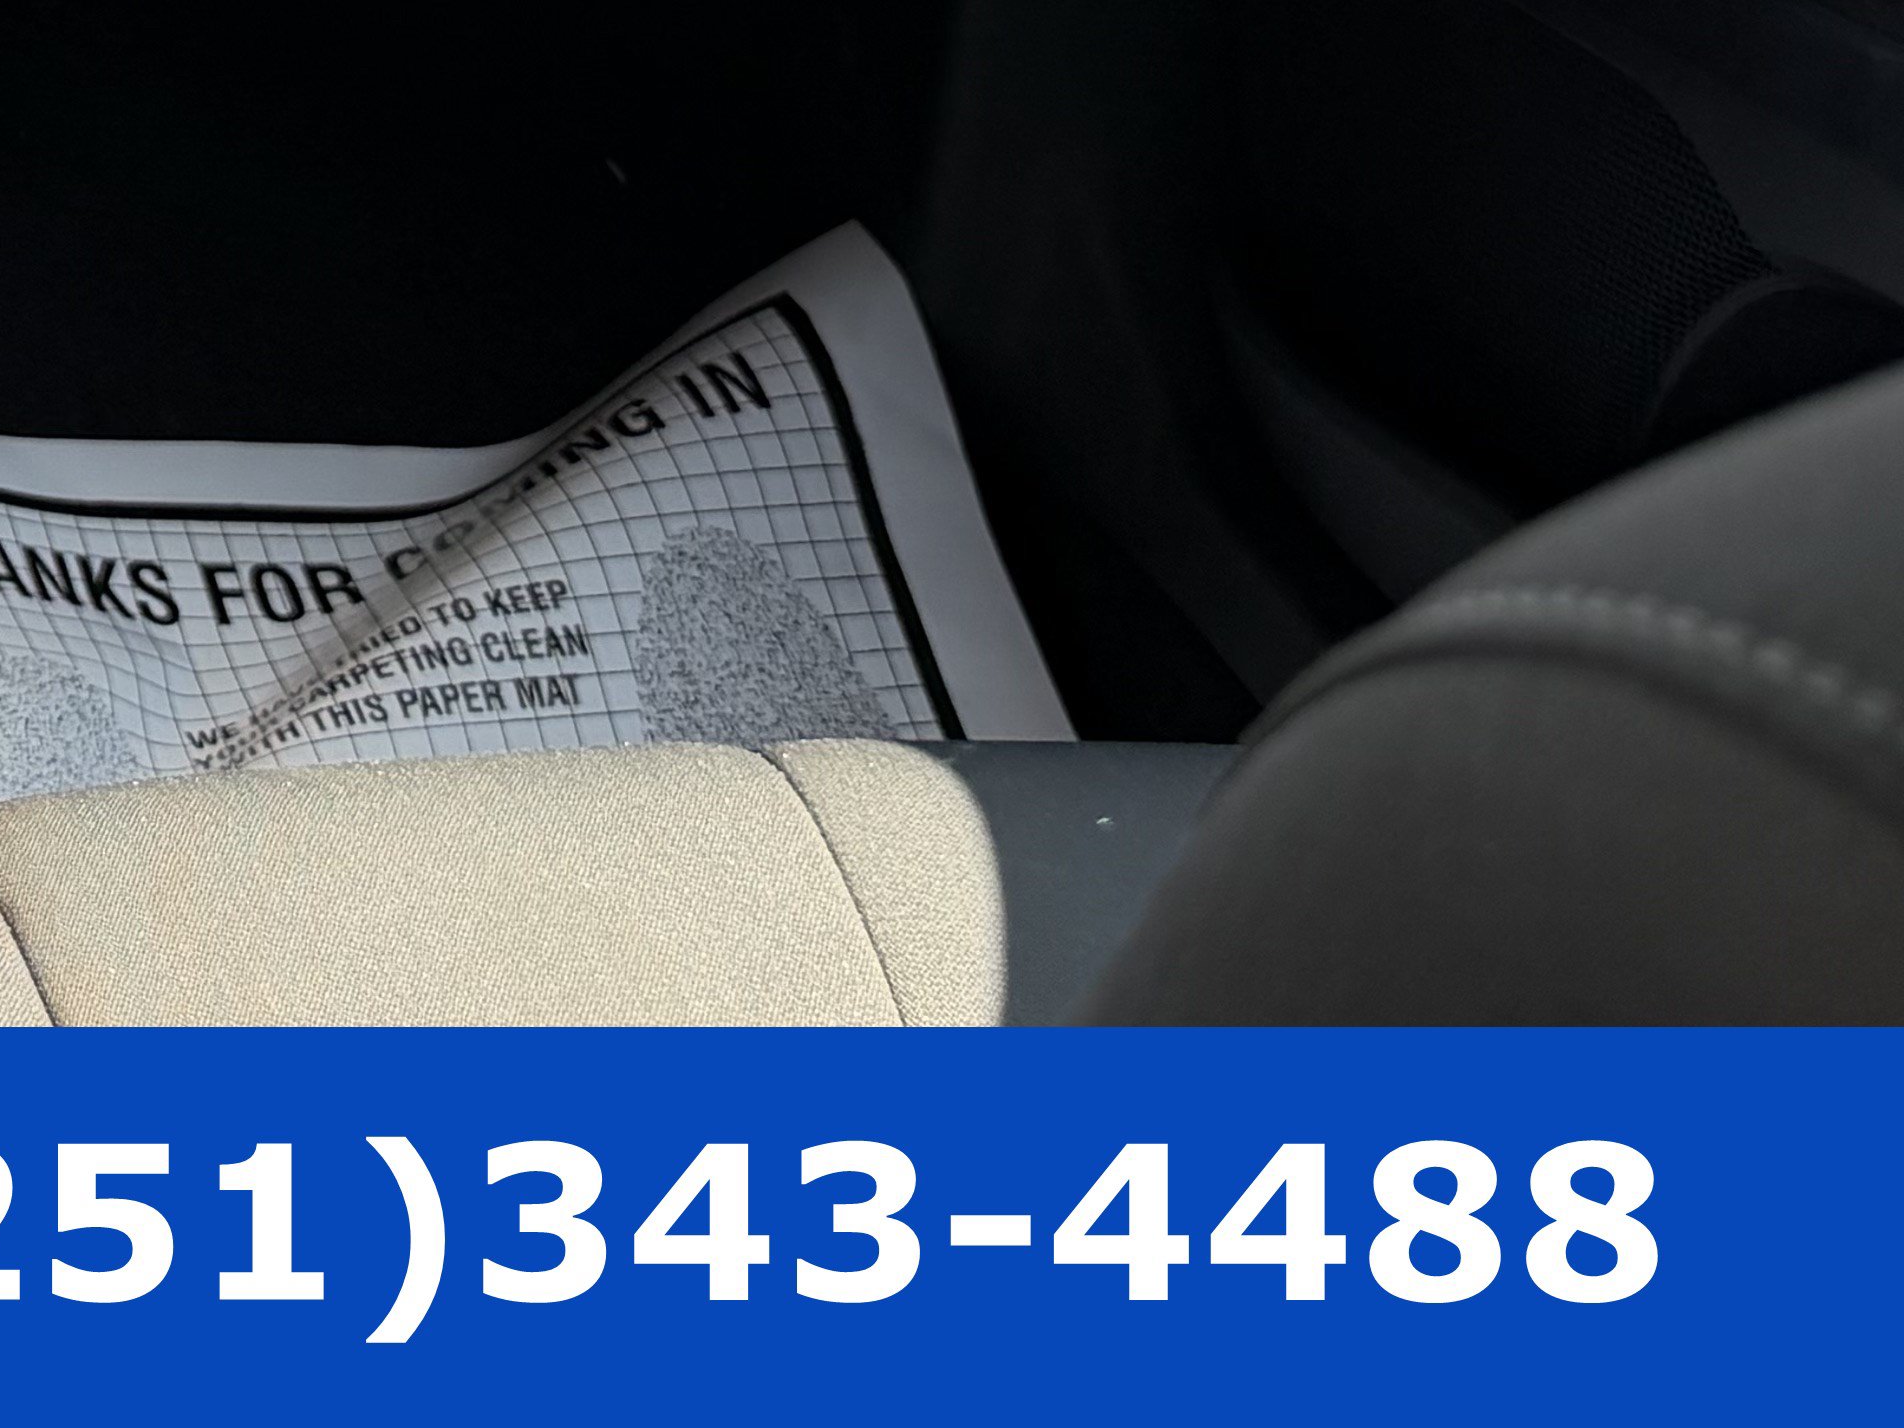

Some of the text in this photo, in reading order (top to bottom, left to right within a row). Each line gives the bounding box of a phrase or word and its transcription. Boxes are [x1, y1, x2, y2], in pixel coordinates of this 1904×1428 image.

[204, 562, 364, 625] FOR
[675, 351, 771, 418] IN
[186, 719, 240, 749] WE
[428, 597, 476, 627] TO
[485, 578, 569, 617] KEEP
[484, 624, 590, 663] CLEAN
[305, 694, 389, 732] THIS
[397, 679, 508, 720] PAPER
[514, 673, 586, 709] MAT
